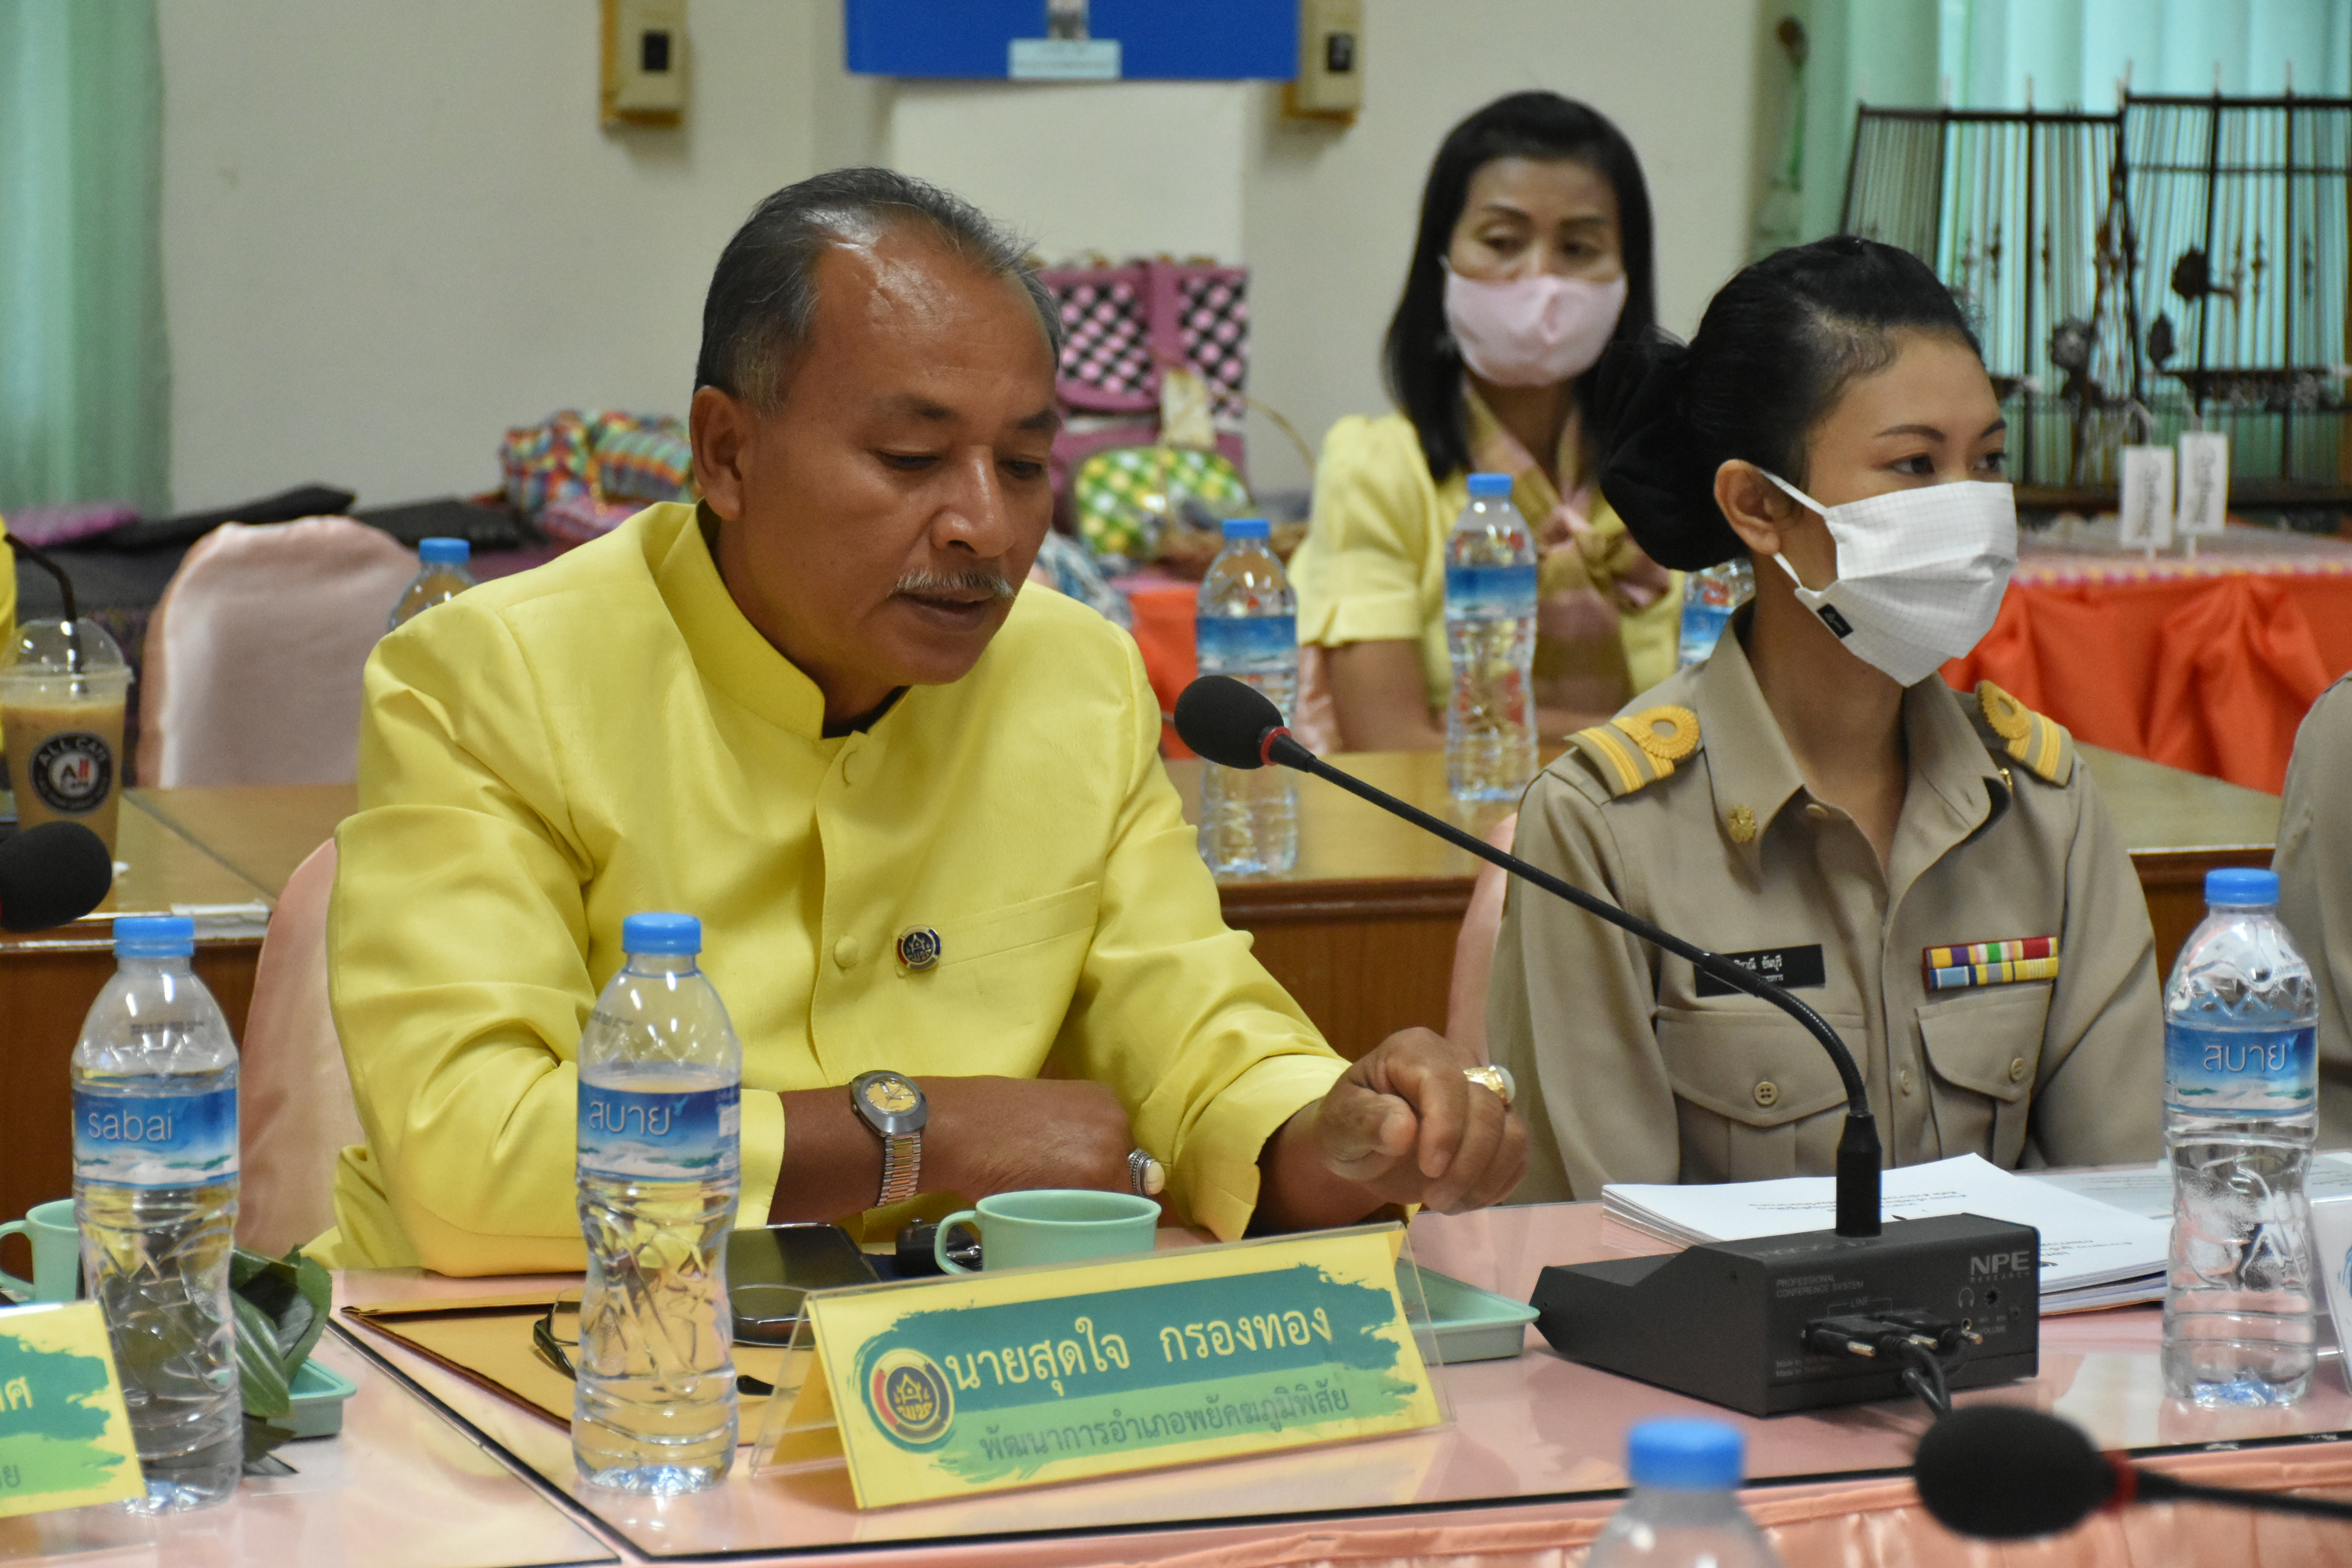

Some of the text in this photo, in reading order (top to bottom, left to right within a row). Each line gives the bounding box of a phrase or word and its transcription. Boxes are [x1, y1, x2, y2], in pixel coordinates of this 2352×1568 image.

[2203, 1044, 2286, 1071] สบาย
[88, 1109, 173, 1141] sabai
[589, 1100, 671, 1135] สบาย
[1971, 1250, 2030, 1276] NPE
[1777, 1274, 1835, 1287] PROFESSIONAL
[1777, 1281, 1864, 1298] CONFERENCE SYSTEM
[1970, 1271, 2030, 1283] RESEARCH
[1851, 1296, 1870, 1308] LINE
[945, 1307, 1333, 1397] นายสุดใจ กรองทอง
[980, 1379, 1350, 1461] พัฒนาการอำเภอพยัคฆภูมิพิสัย
